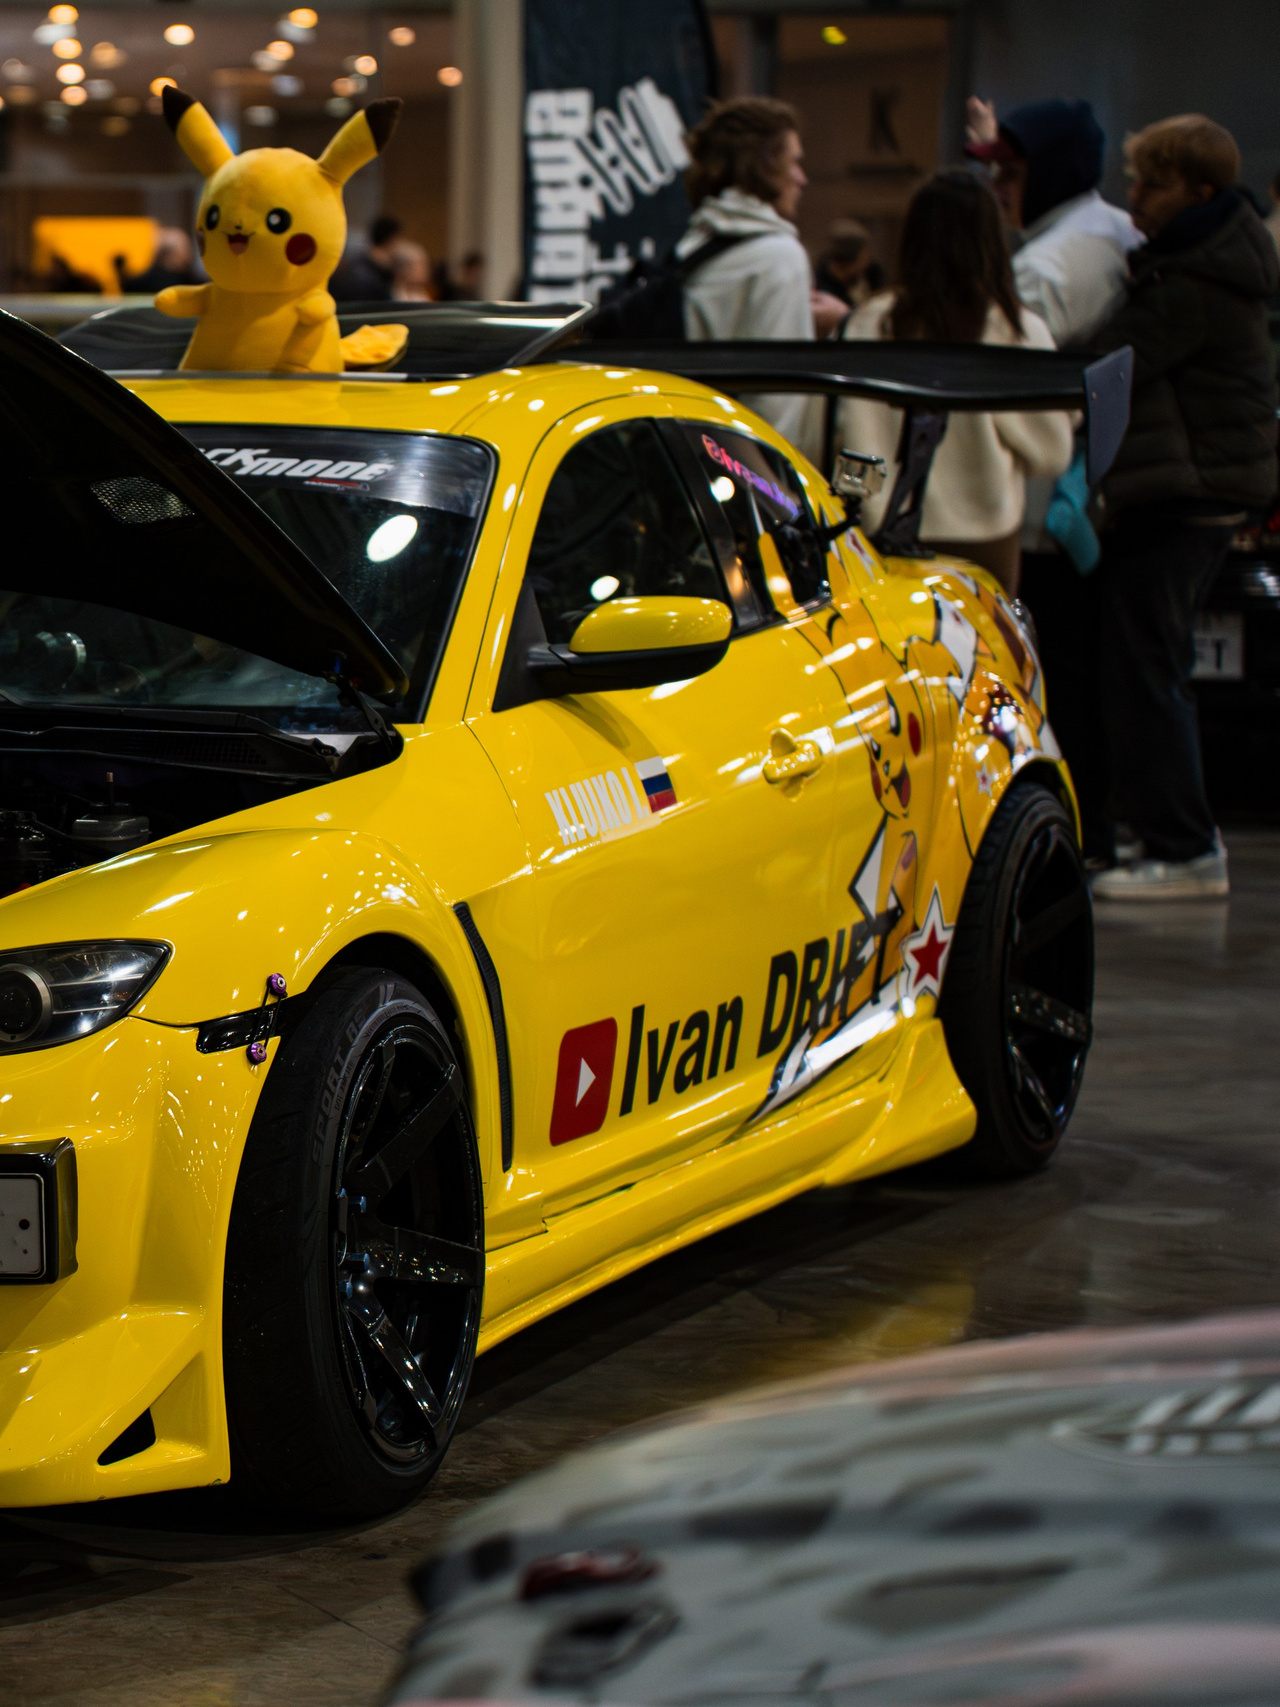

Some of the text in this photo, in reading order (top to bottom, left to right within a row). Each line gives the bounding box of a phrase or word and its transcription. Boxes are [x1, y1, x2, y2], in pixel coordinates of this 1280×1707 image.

[619, 912, 894, 1118] Ivan DRIFT
[312, 1046, 346, 1164] SPORT
